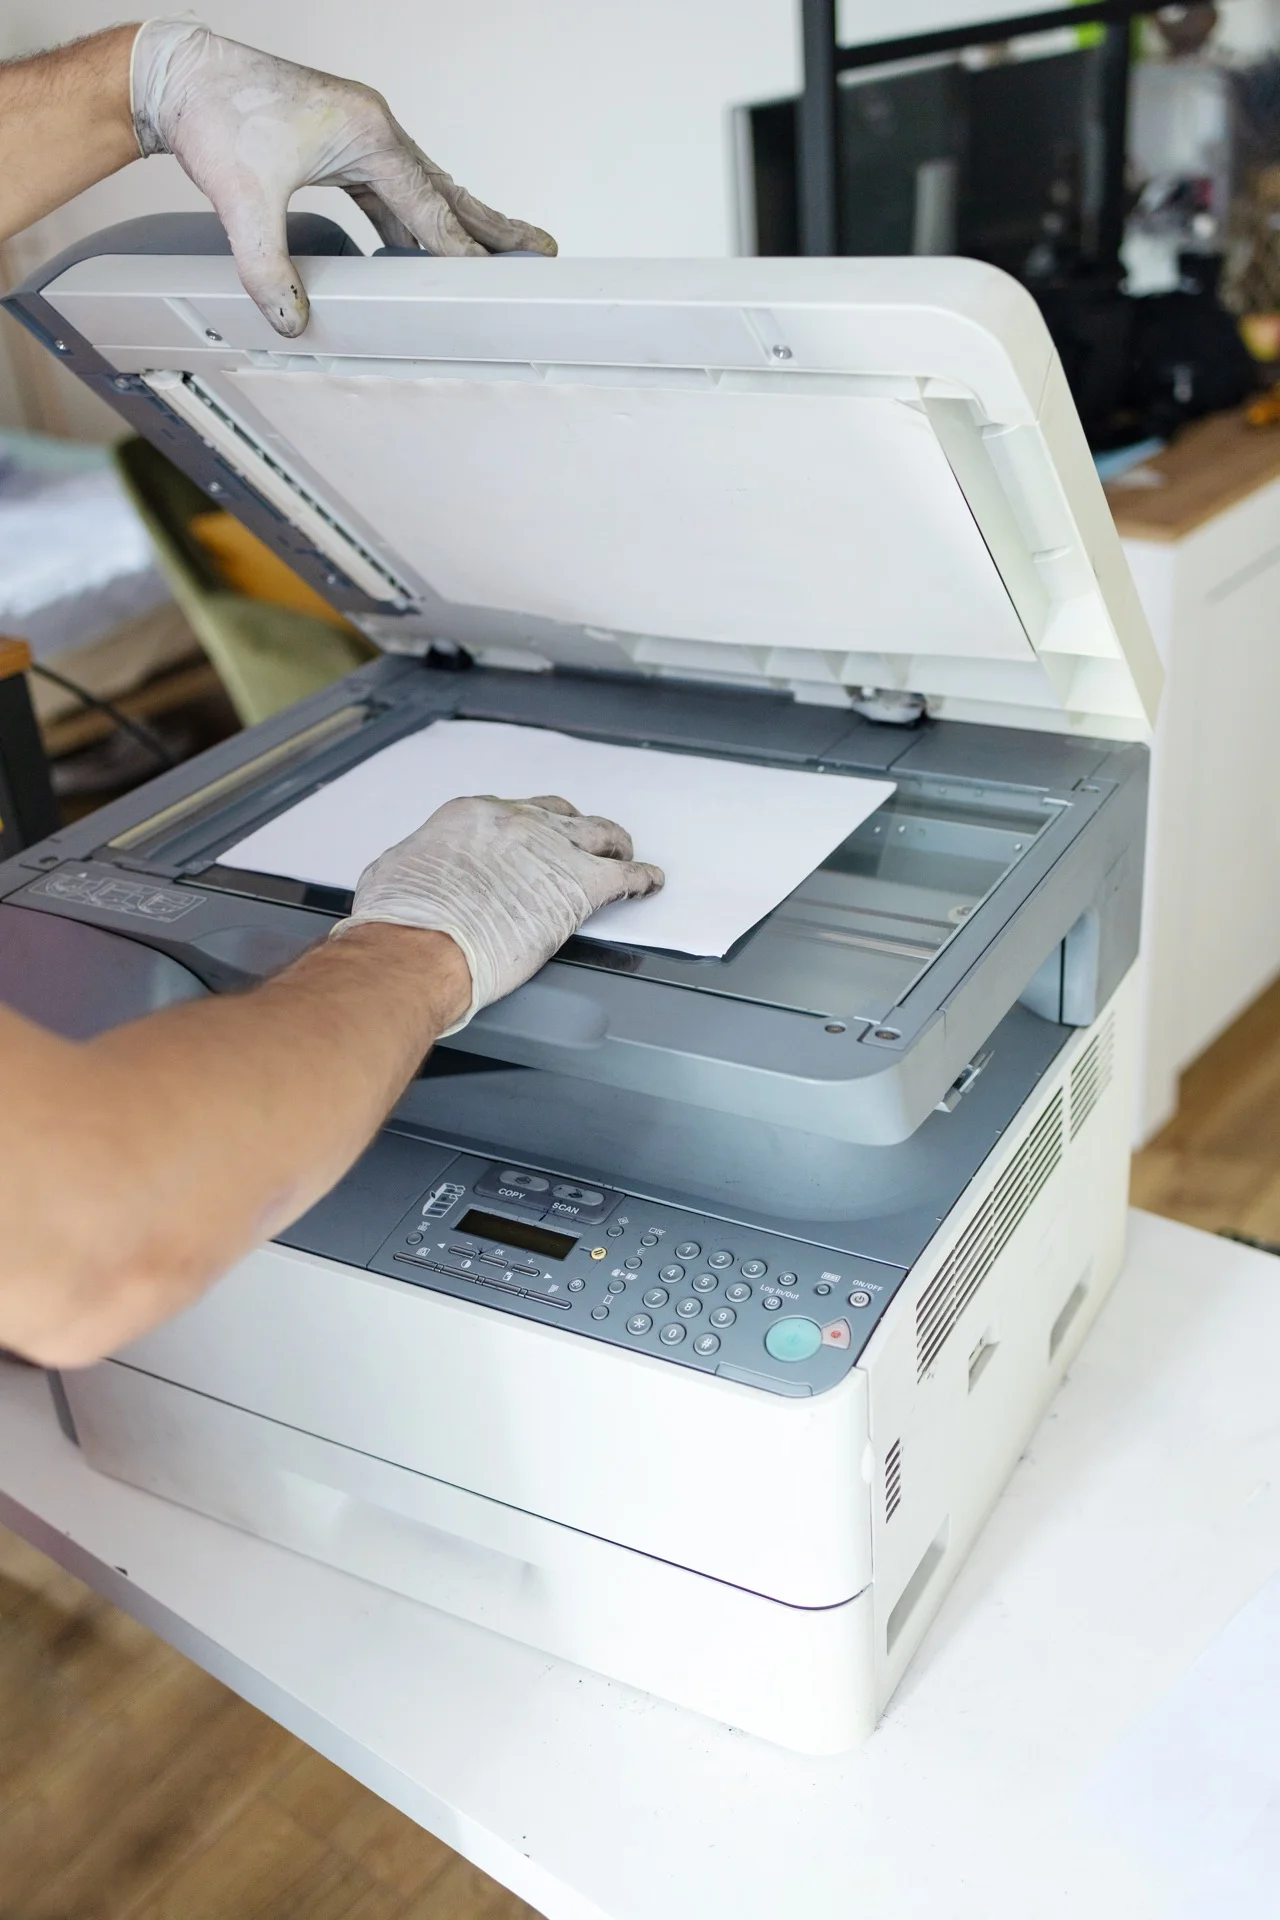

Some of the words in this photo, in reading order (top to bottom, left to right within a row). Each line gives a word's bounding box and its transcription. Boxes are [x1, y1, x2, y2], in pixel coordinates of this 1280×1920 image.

[498, 1188, 526, 1200] COPY
[552, 1202, 580, 1215] SCAN
[495, 1248, 505, 1257] OK
[685, 1246, 692, 1254] 1
[716, 1255, 725, 1264] 2
[667, 1269, 676, 1277] 4
[749, 1264, 759, 1273] 3
[700, 1278, 710, 1287] 5
[853, 1279, 884, 1292] ON/OFF
[652, 1292, 661, 1301] 7
[733, 1287, 743, 1297] 6
[760, 1284, 775, 1295] Log
[776, 1288, 800, 1300] In/Out
[767, 1297, 778, 1306] ID
[684, 1302, 693, 1312] 8
[718, 1312, 727, 1321] 9
[668, 1329, 677, 1338] 0
